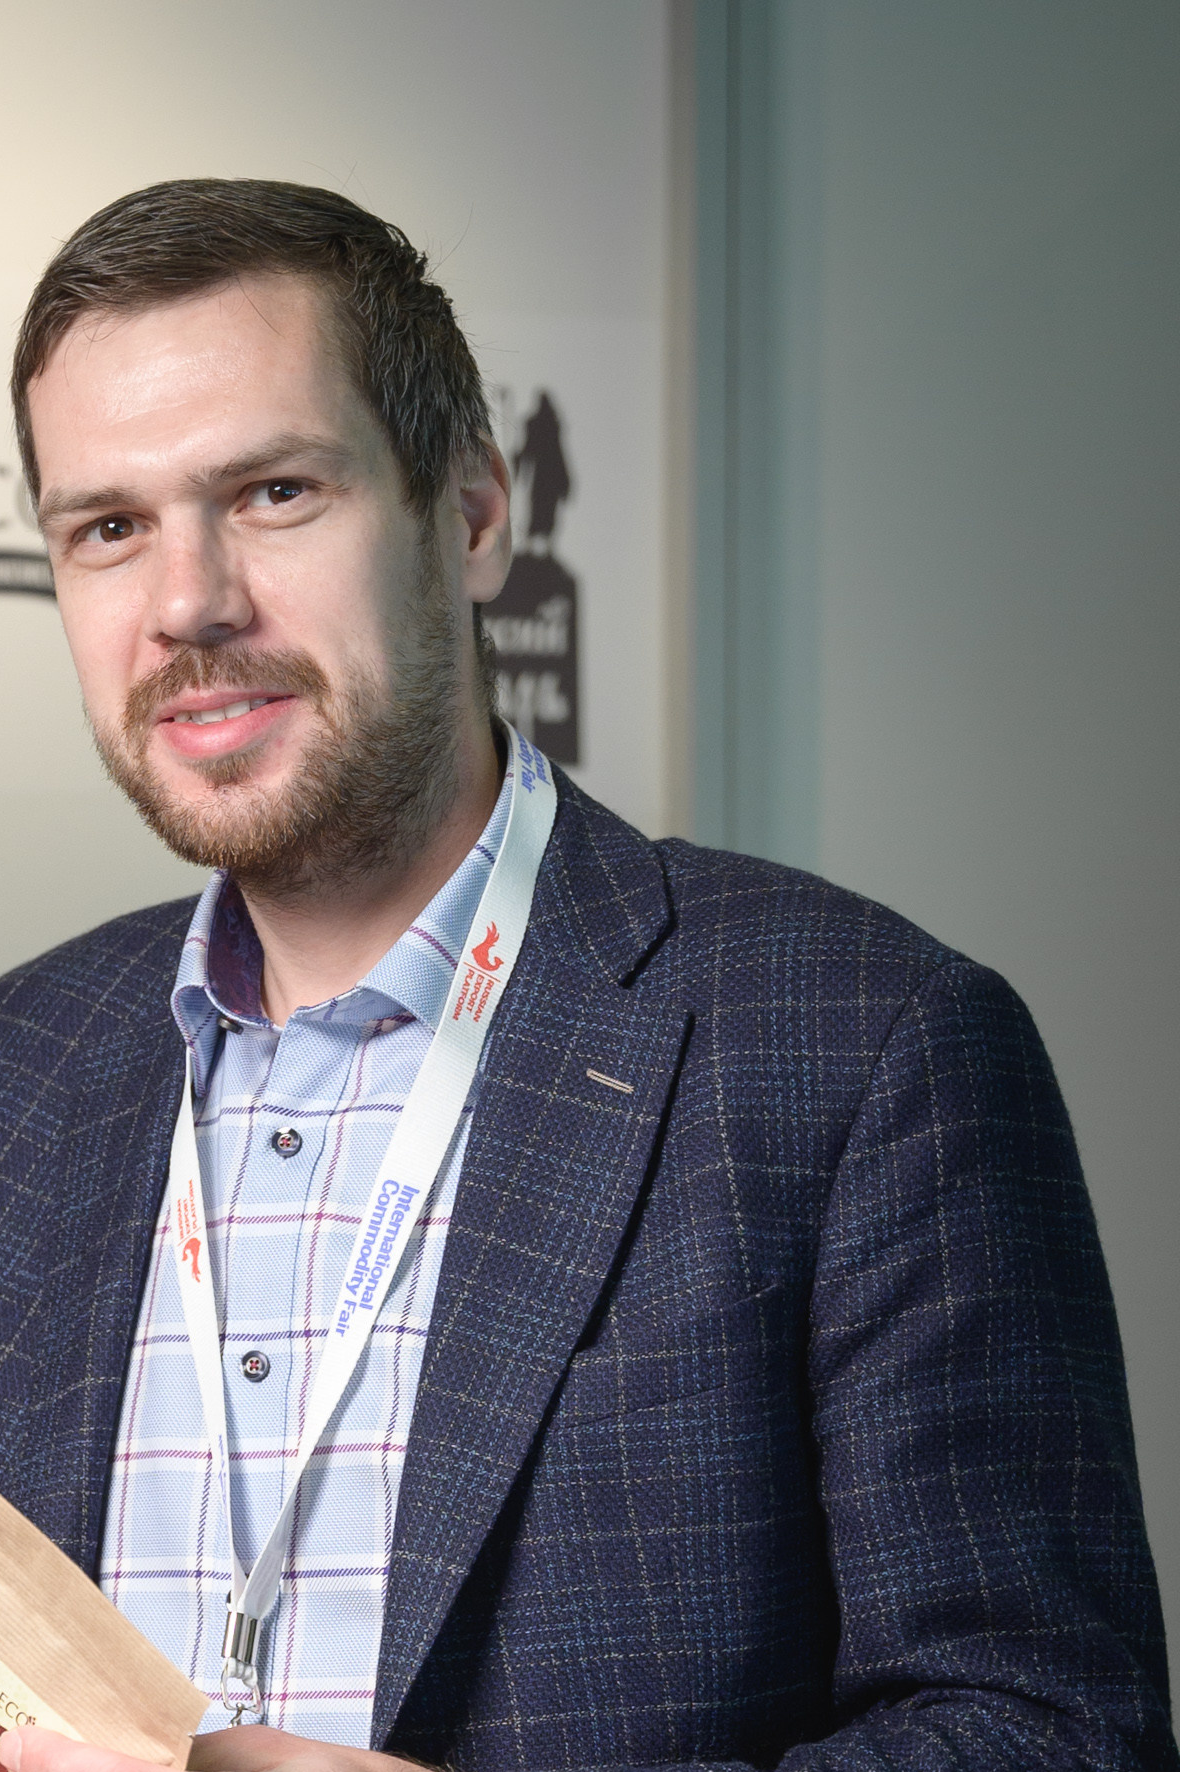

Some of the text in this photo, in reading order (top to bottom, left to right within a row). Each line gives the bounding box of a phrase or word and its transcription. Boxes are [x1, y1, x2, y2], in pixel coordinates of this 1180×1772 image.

[452, 968, 476, 1021] PLATFORM
[465, 974, 485, 1012] EXPORT
[473, 979, 495, 1023] RUSSIAN
[335, 1178, 400, 1338] Commodity Fair
[358, 1184, 420, 1311] International
